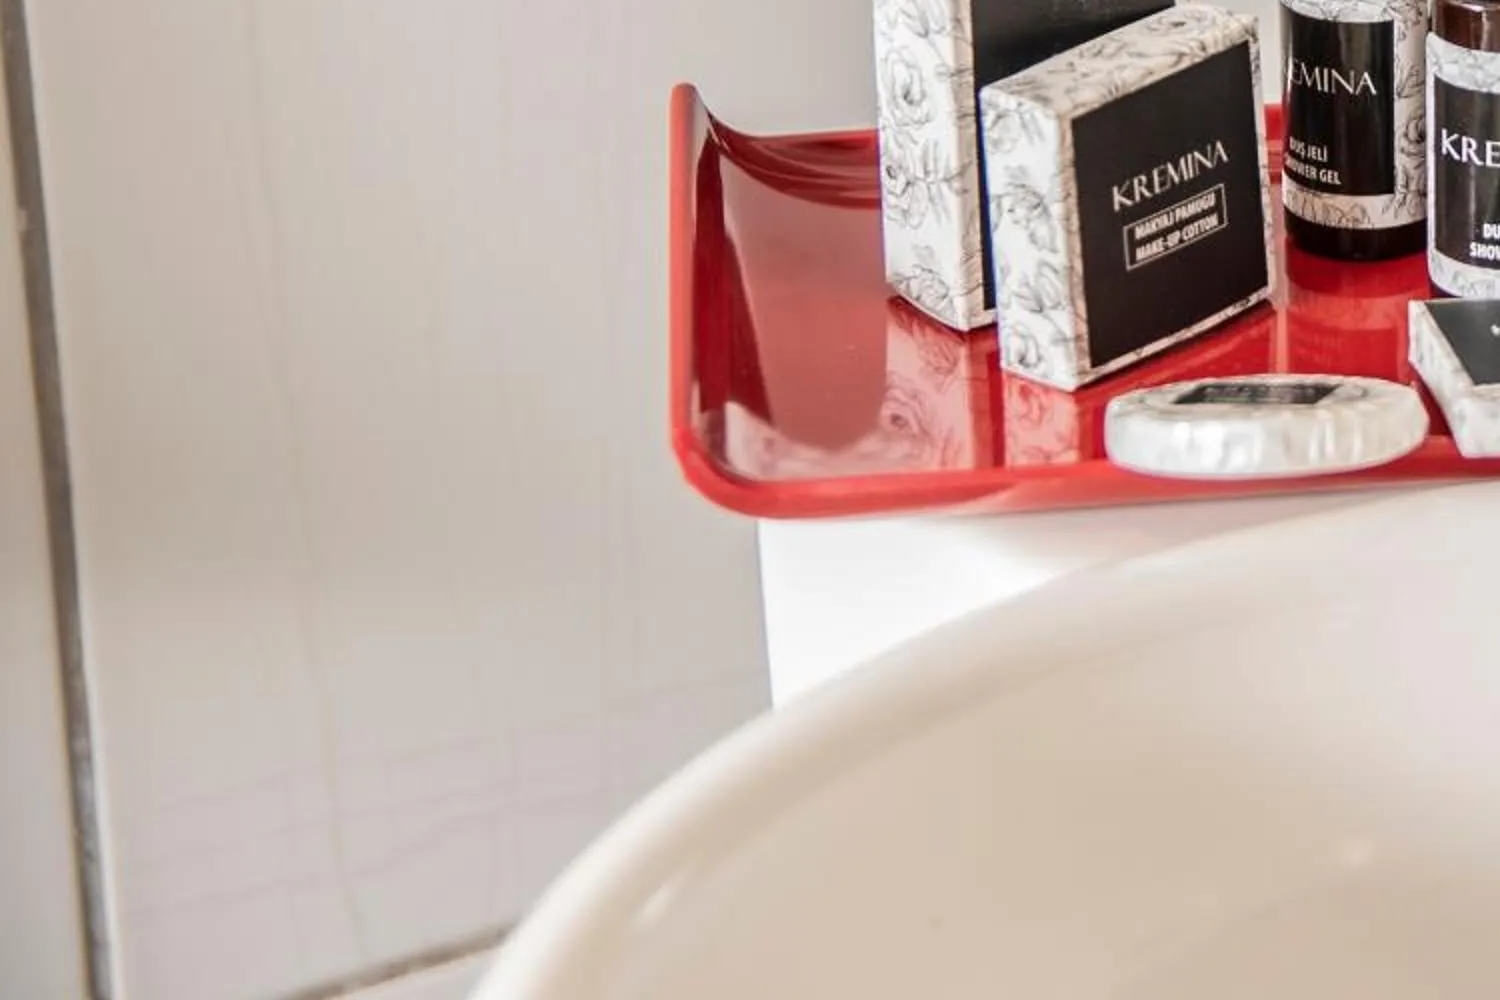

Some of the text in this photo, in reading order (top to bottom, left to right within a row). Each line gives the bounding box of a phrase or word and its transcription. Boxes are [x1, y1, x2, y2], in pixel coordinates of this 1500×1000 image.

[1111, 139, 1229, 214] KREMINA
[1319, 168, 1342, 185] GEL
[1135, 213, 1219, 261] MAKE-UP COTTON
